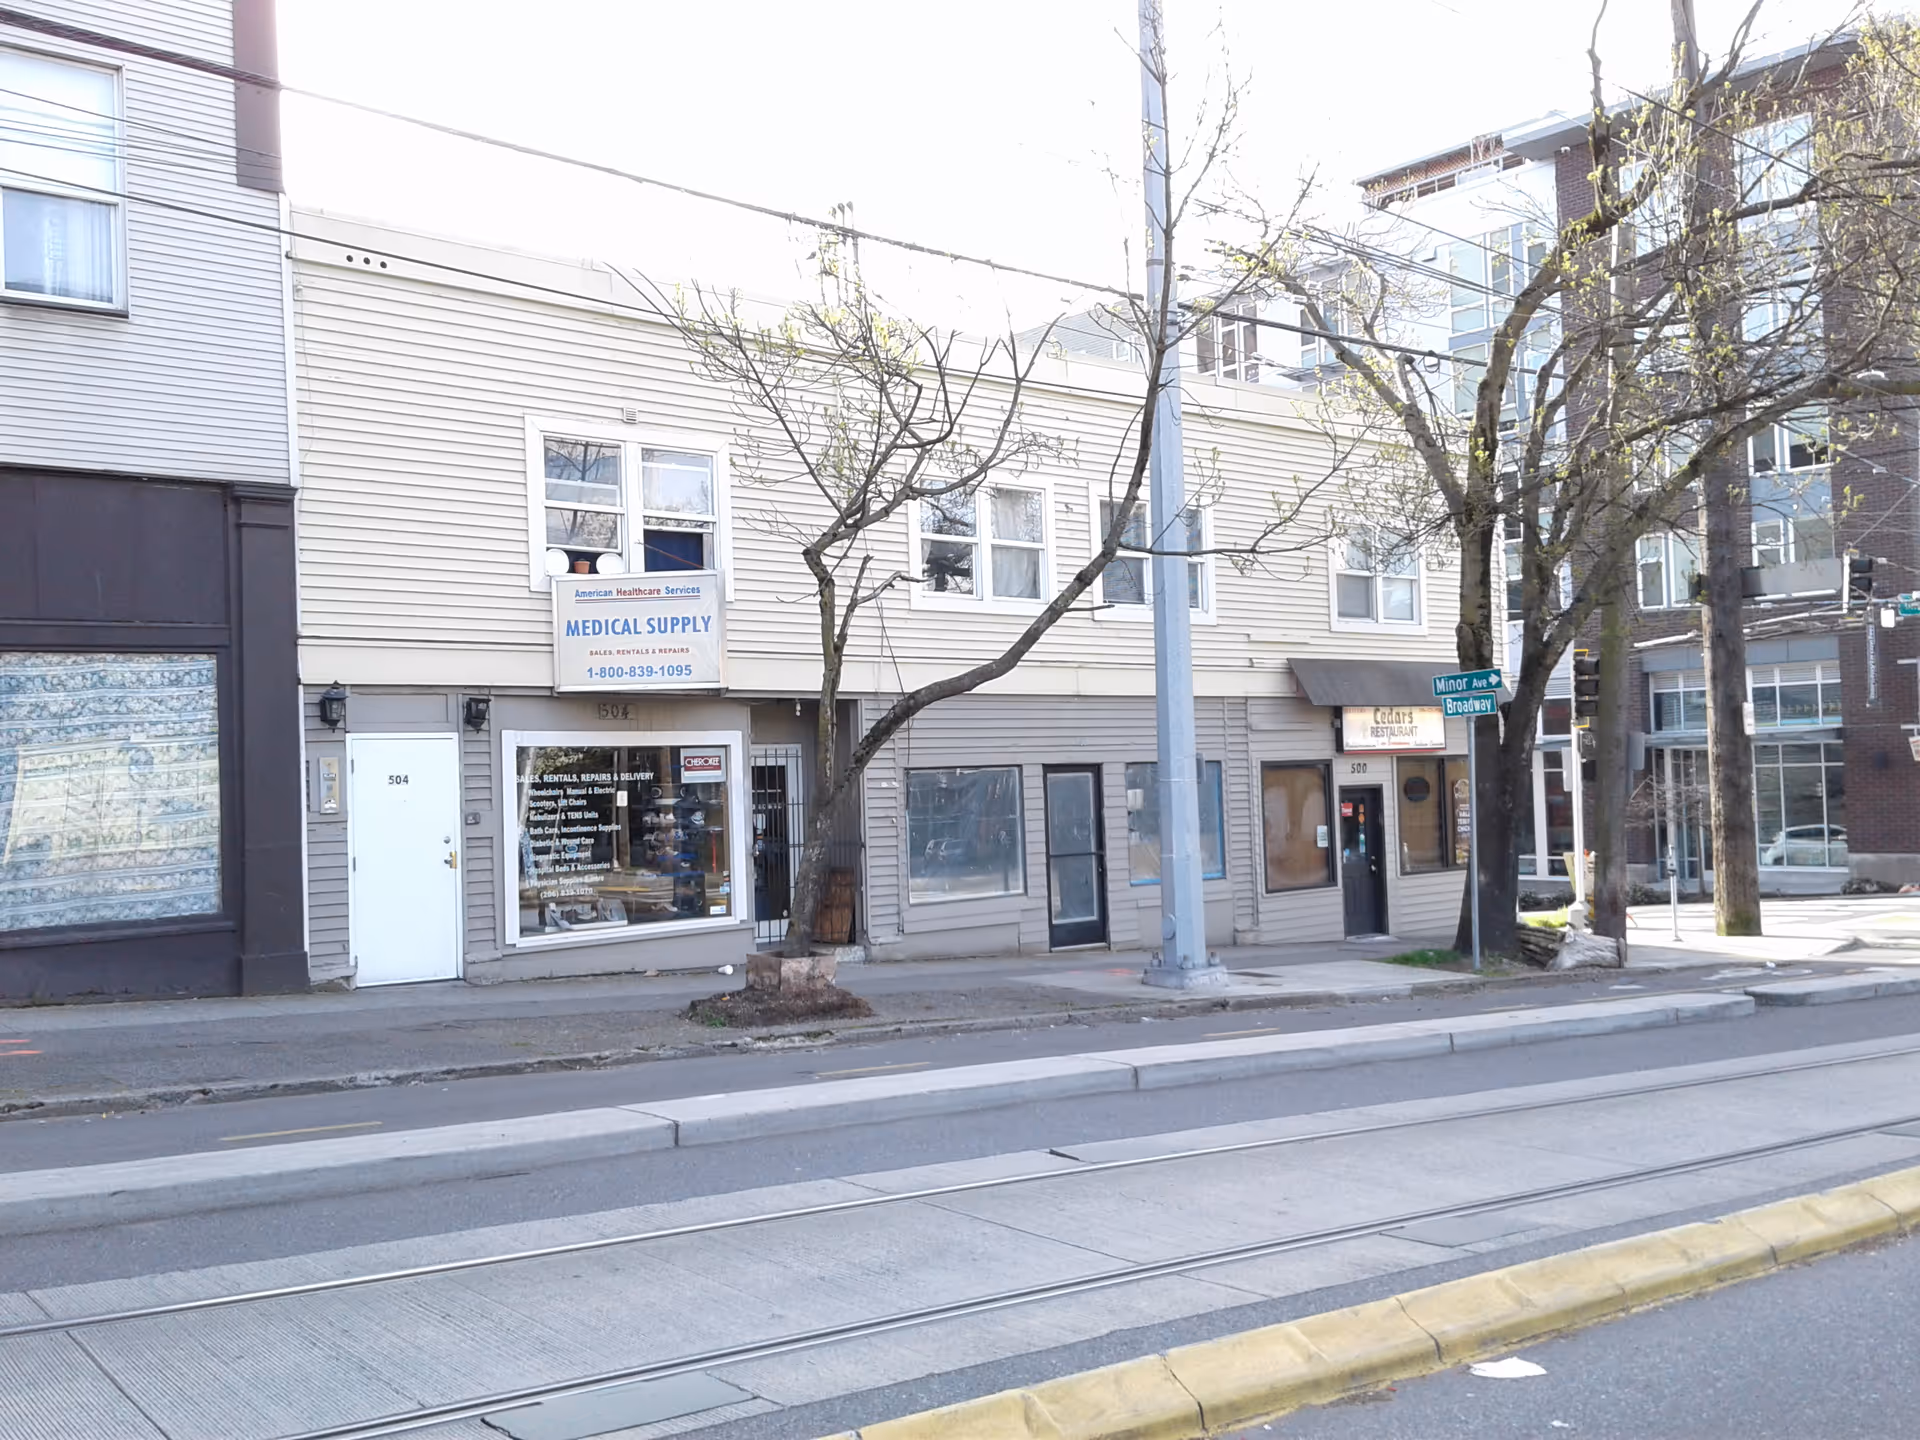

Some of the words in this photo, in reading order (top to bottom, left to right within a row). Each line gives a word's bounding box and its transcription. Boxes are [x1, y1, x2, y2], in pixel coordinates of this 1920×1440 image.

[575, 589, 613, 598] American
[616, 587, 661, 597] Healthcare
[665, 585, 701, 595] Services
[566, 618, 642, 637] MEDICAL
[647, 615, 712, 634] SUPPLY
[587, 665, 692, 678] 1-800-839-1095
[1436, 678, 1468, 693] Minor
[1472, 677, 1487, 688] Ave
[1446, 697, 1491, 713] Broadway
[599, 704, 629, 719] 504
[1374, 707, 1413, 725] Cedars
[1370, 725, 1418, 738] RESTAURANT
[685, 757, 720, 767] CHEROKEE
[1351, 762, 1367, 774] 500
[388, 775, 409, 785] 504
[543, 773, 579, 783] RENTALS,
[581, 772, 611, 782] REPAIRS
[613, 772, 618, 780] &
[620, 771, 655, 781] DELIVERY
[588, 786, 593, 794] &
[594, 785, 615, 794] Electric
[569, 798, 587, 806] Chairs
[567, 811, 582, 819] TENS
[577, 862, 610, 870] Accessories
